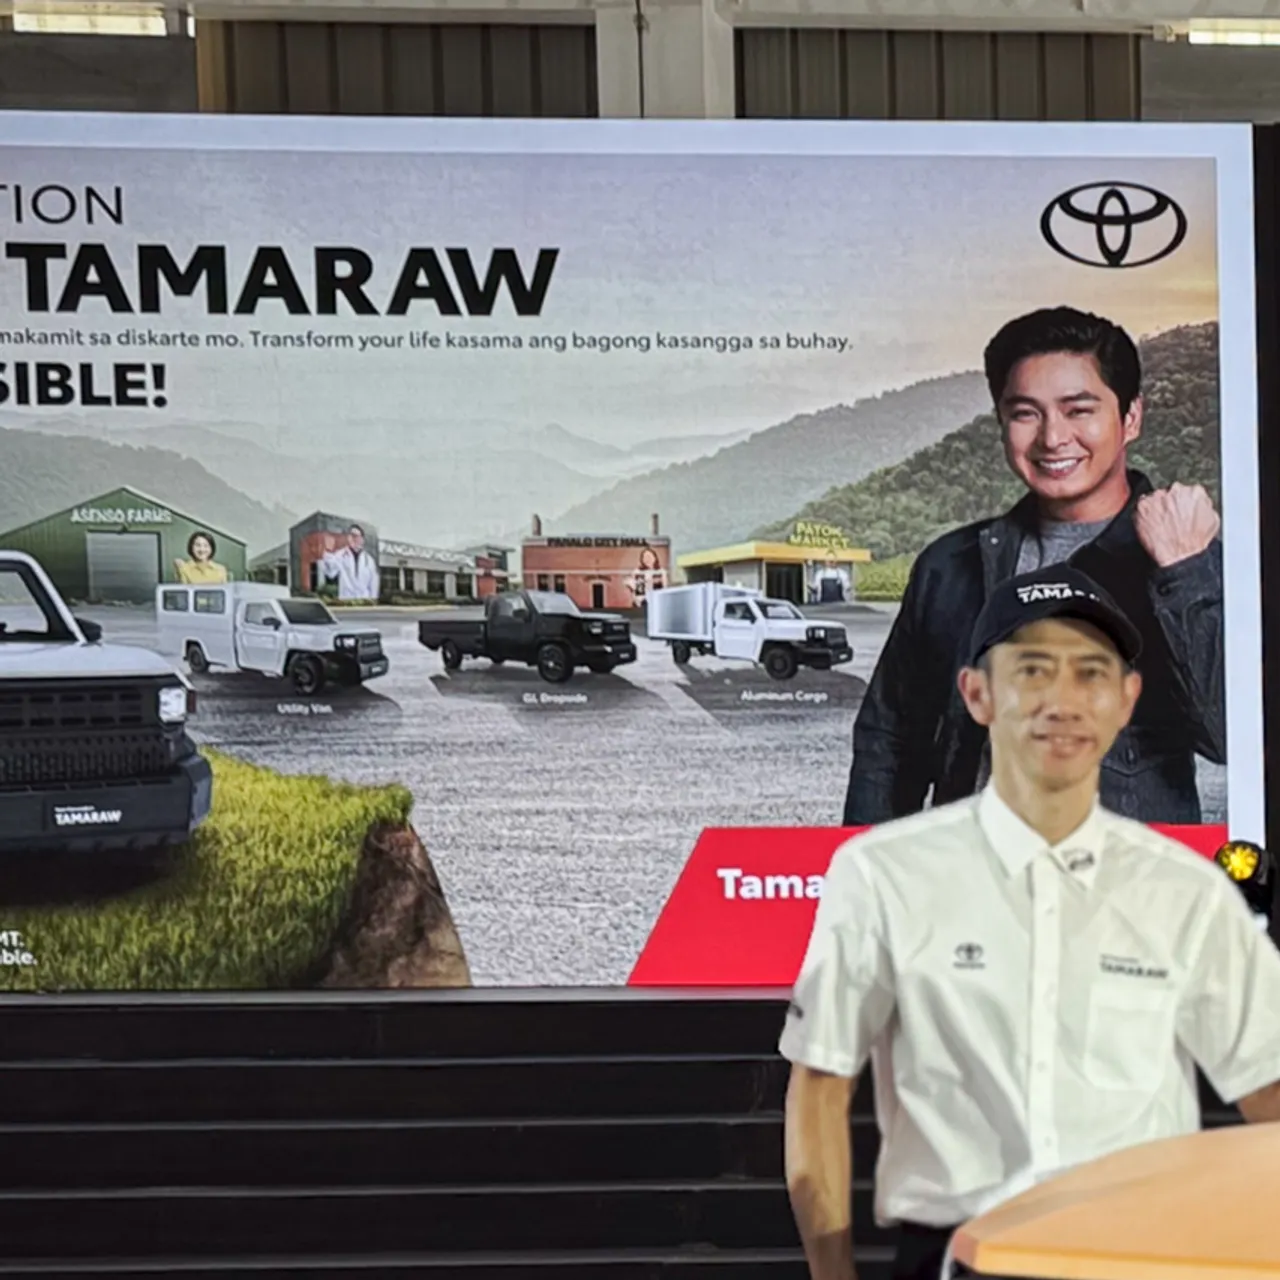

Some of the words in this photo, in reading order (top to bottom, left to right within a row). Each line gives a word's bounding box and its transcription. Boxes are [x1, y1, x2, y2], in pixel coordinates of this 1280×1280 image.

[0, 184, 123, 225] ION
[5, 241, 561, 317] TAMARAW
[89, 332, 111, 346] sa
[117, 329, 200, 347] diskarte
[206, 333, 245, 348] mo.
[249, 330, 354, 349] Transform
[358, 333, 404, 352] your
[409, 331, 441, 348] life
[446, 331, 524, 349] kasama
[529, 333, 567, 352] ang
[572, 331, 651, 353] bagong
[656, 332, 753, 353] kasangga
[759, 335, 780, 349] sa
[0, 361, 168, 409] IBLE!
